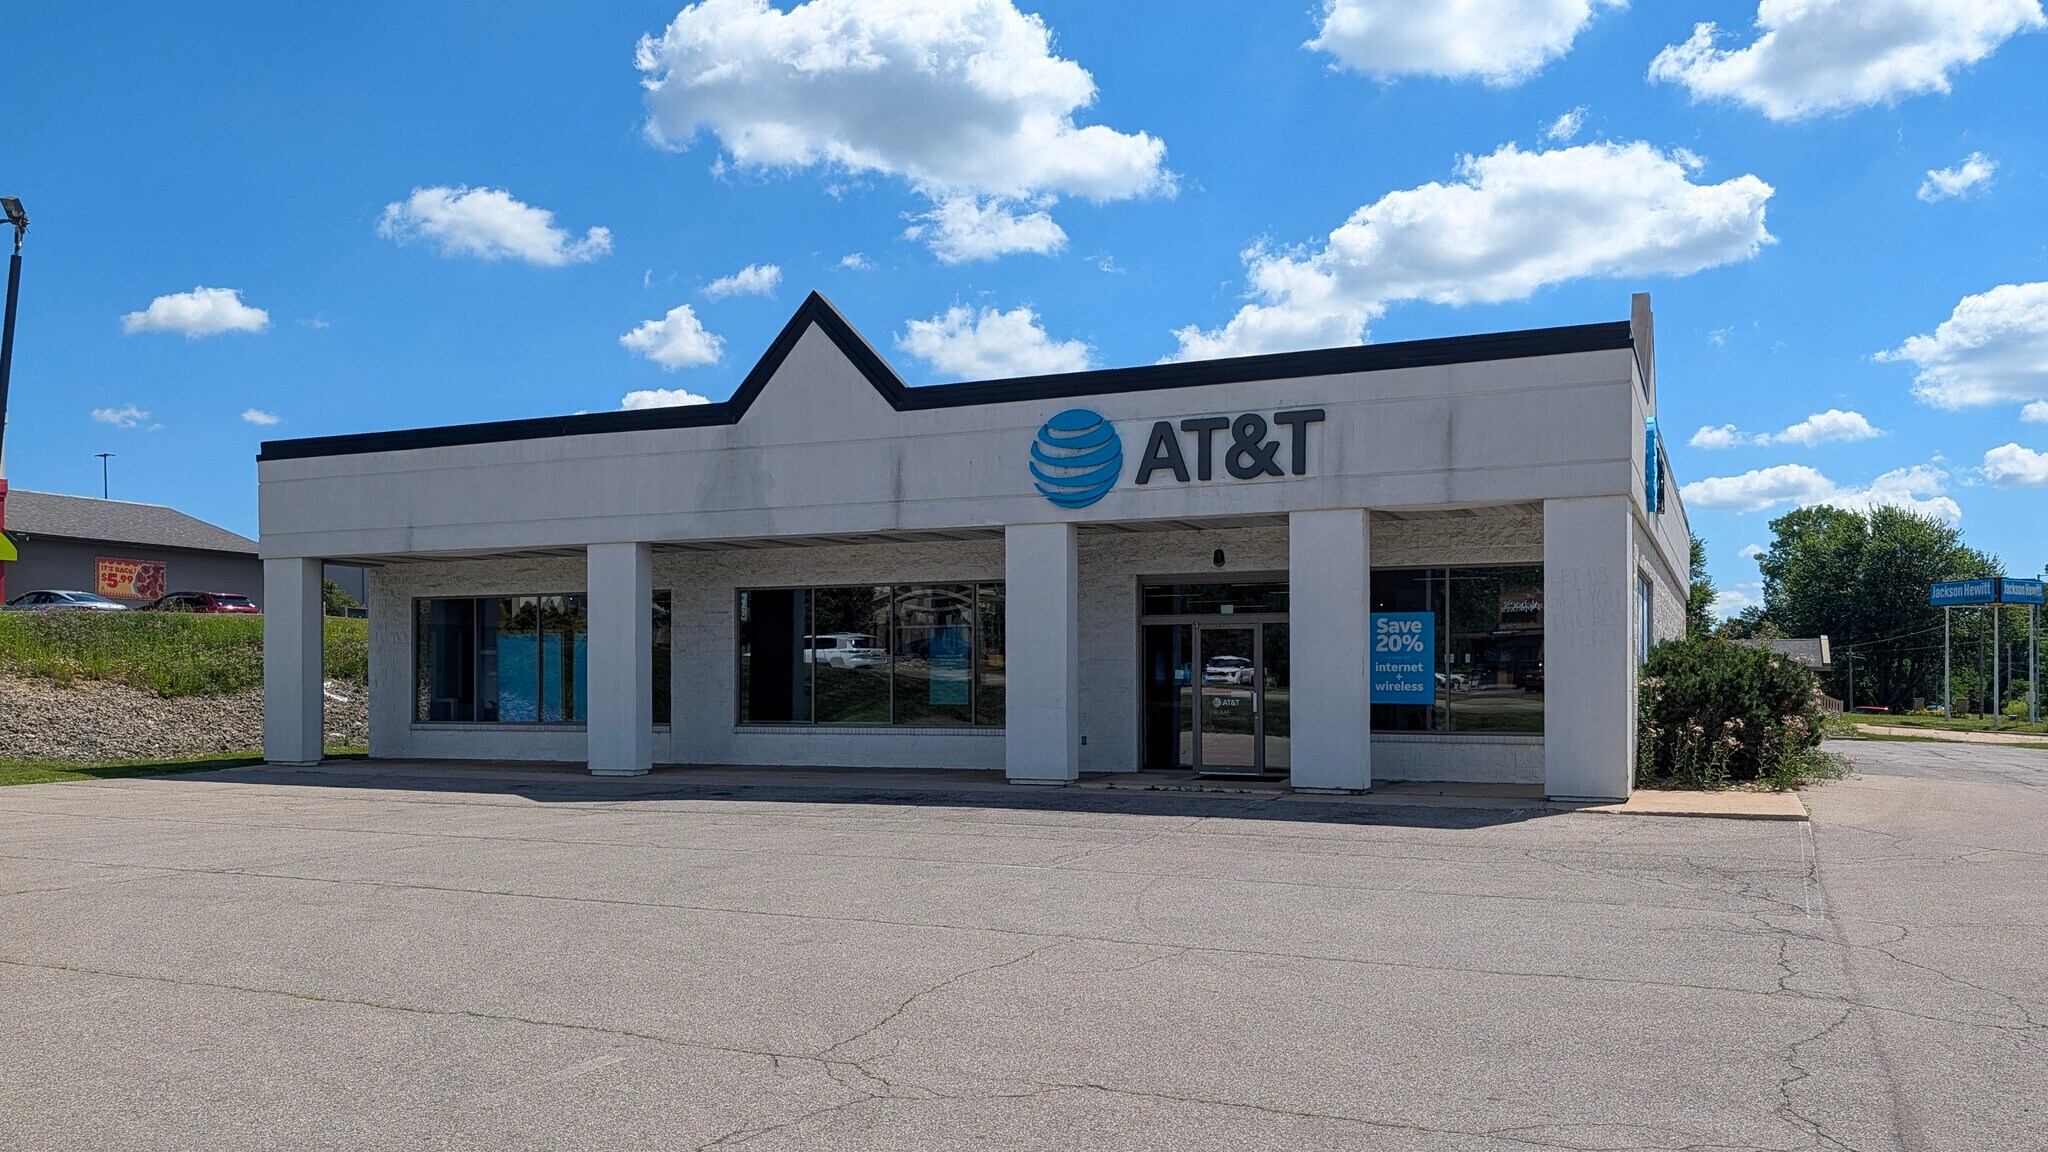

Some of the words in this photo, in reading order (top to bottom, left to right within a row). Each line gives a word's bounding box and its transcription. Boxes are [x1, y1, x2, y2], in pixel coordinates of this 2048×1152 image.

[1135, 408, 1326, 485] AT&T
[115, 566, 137, 575] BACK!
[101, 573, 134, 588] $5.99
[1932, 585, 1963, 599] Jackson
[1964, 582, 1991, 596] Hewitt
[2003, 582, 2025, 596] Jackson
[2025, 583, 2043, 596] Hewitt
[1376, 617, 1423, 634] Save
[1375, 634, 1424, 652] 20%
[1375, 661, 1424, 672] internet
[1395, 673, 1403, 681] +
[1375, 681, 1424, 691] wireless
